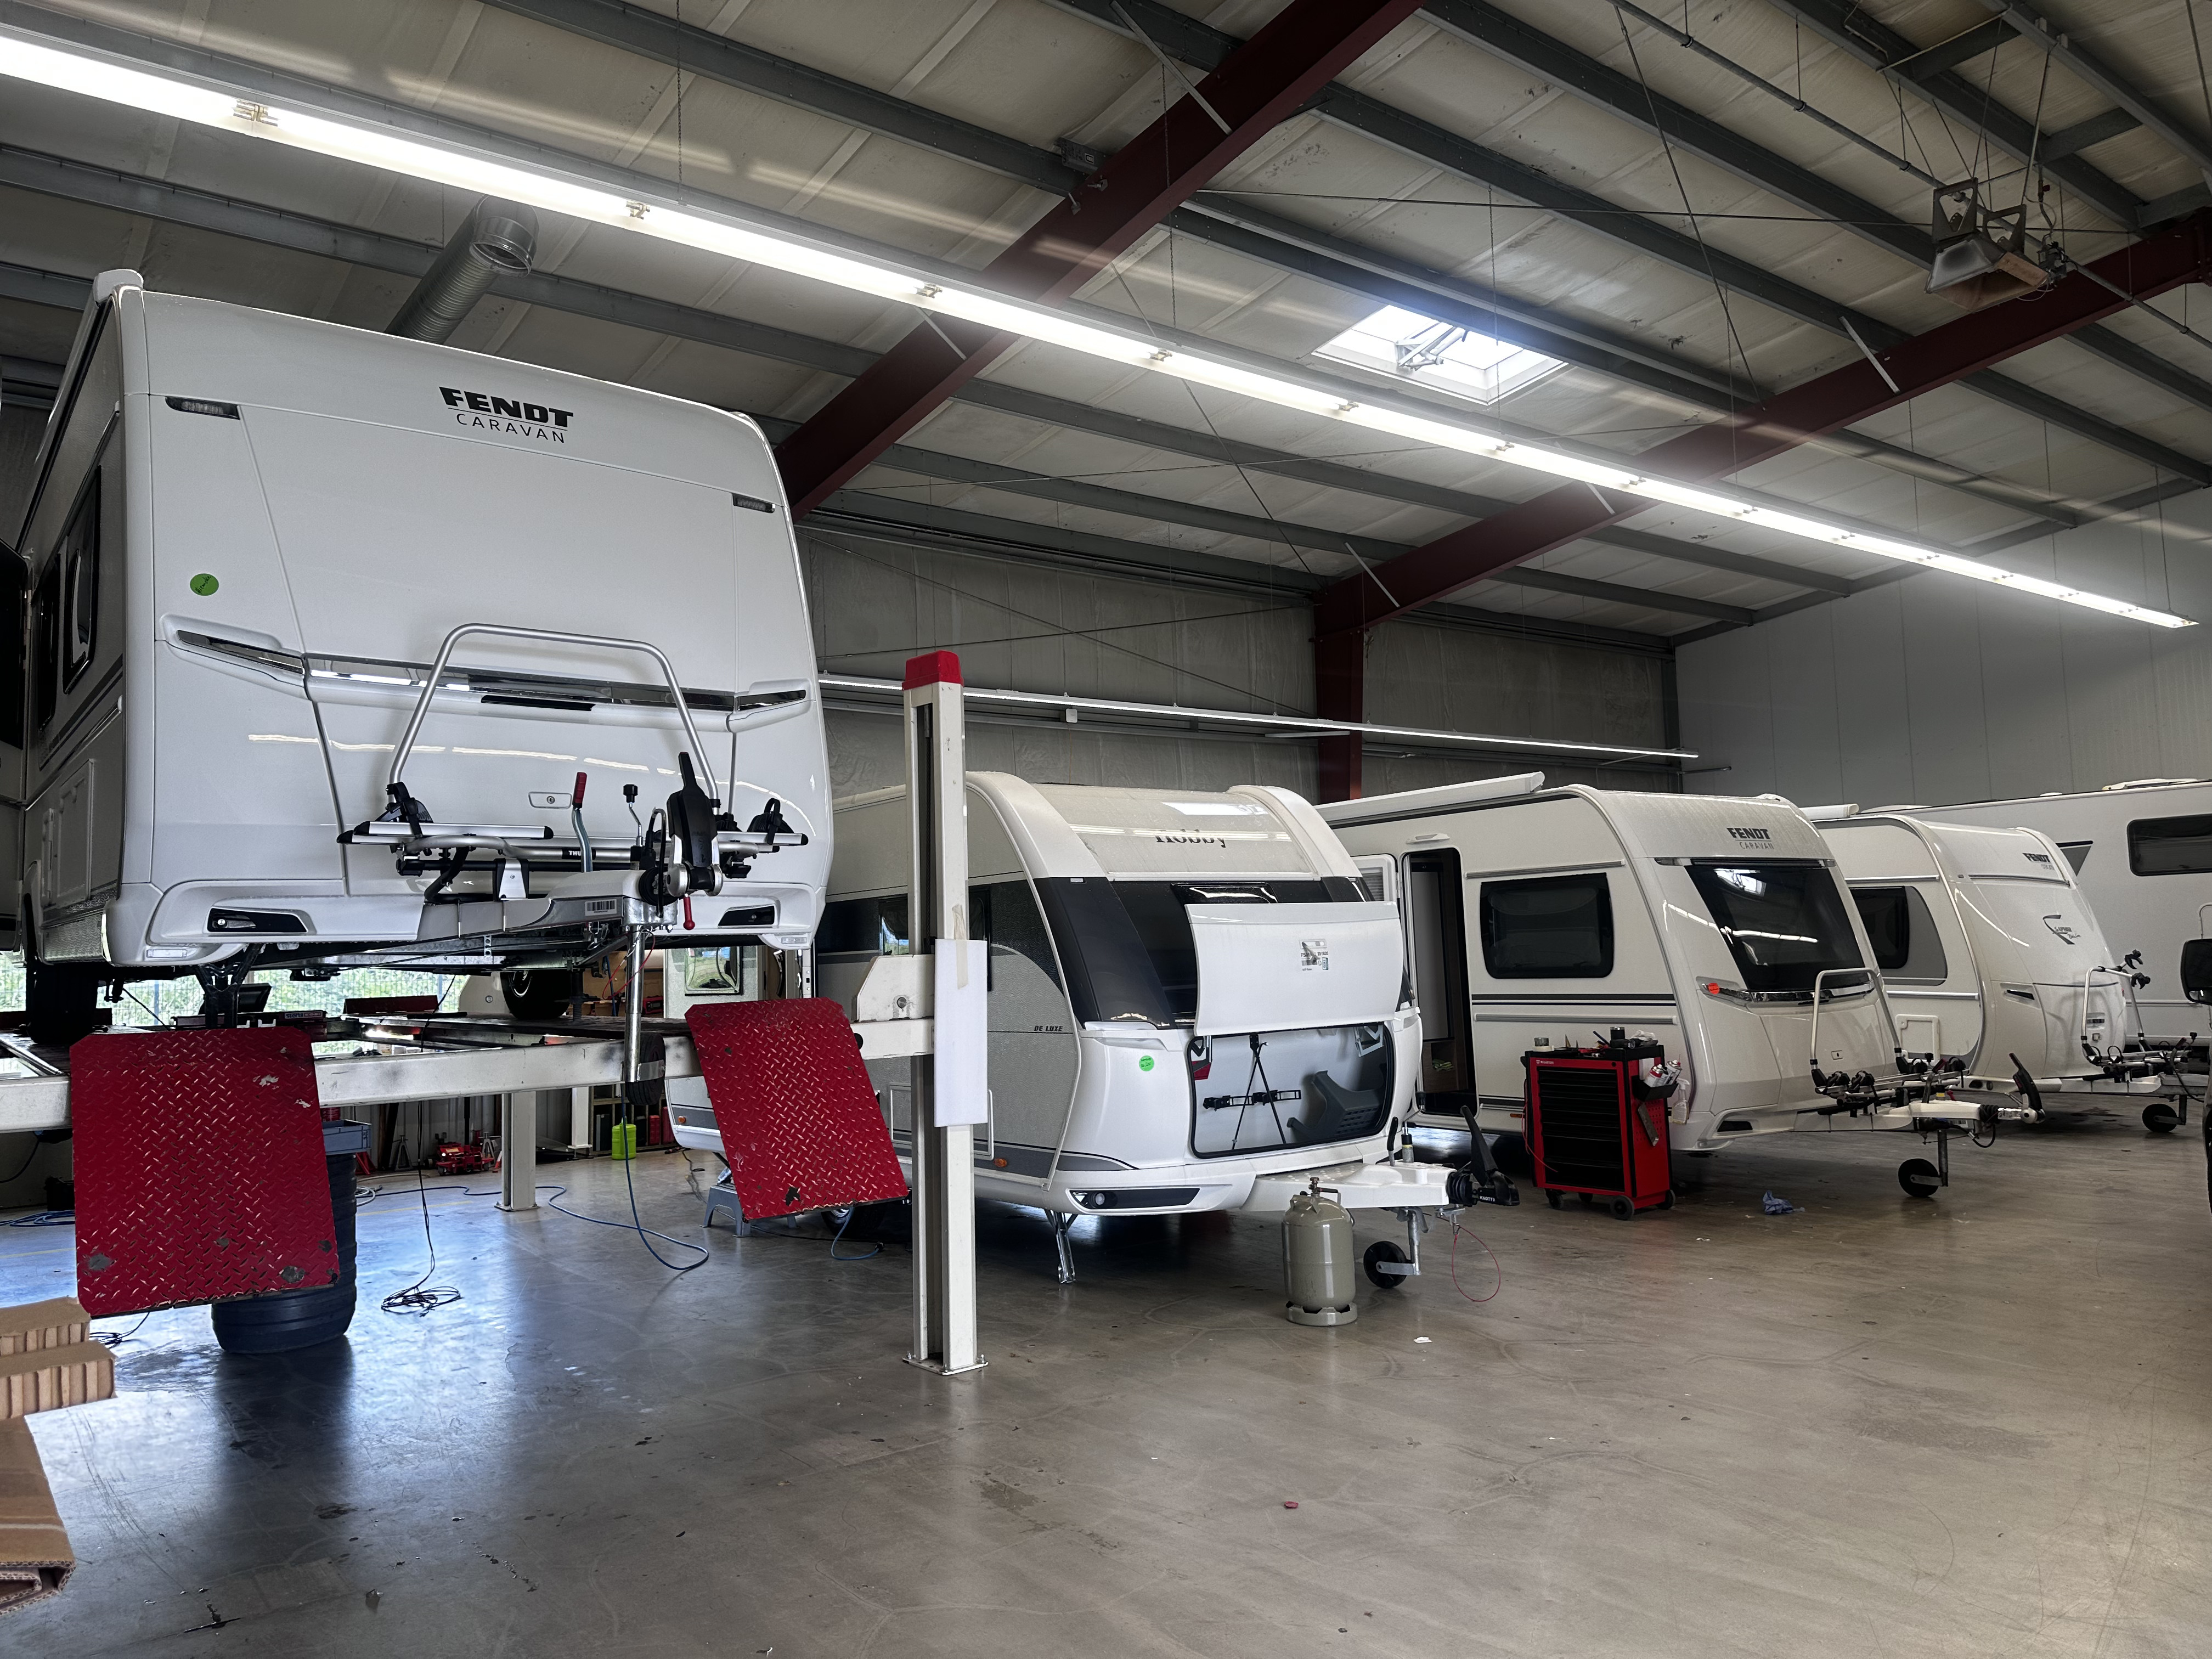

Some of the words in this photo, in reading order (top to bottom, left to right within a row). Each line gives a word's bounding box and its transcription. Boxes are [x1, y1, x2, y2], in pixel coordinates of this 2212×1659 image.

[439, 386, 574, 427] FENDT
[456, 413, 565, 443] CARAVAN
[1726, 827, 1770, 839] FENDT
[2022, 853, 2051, 863] FENDT
